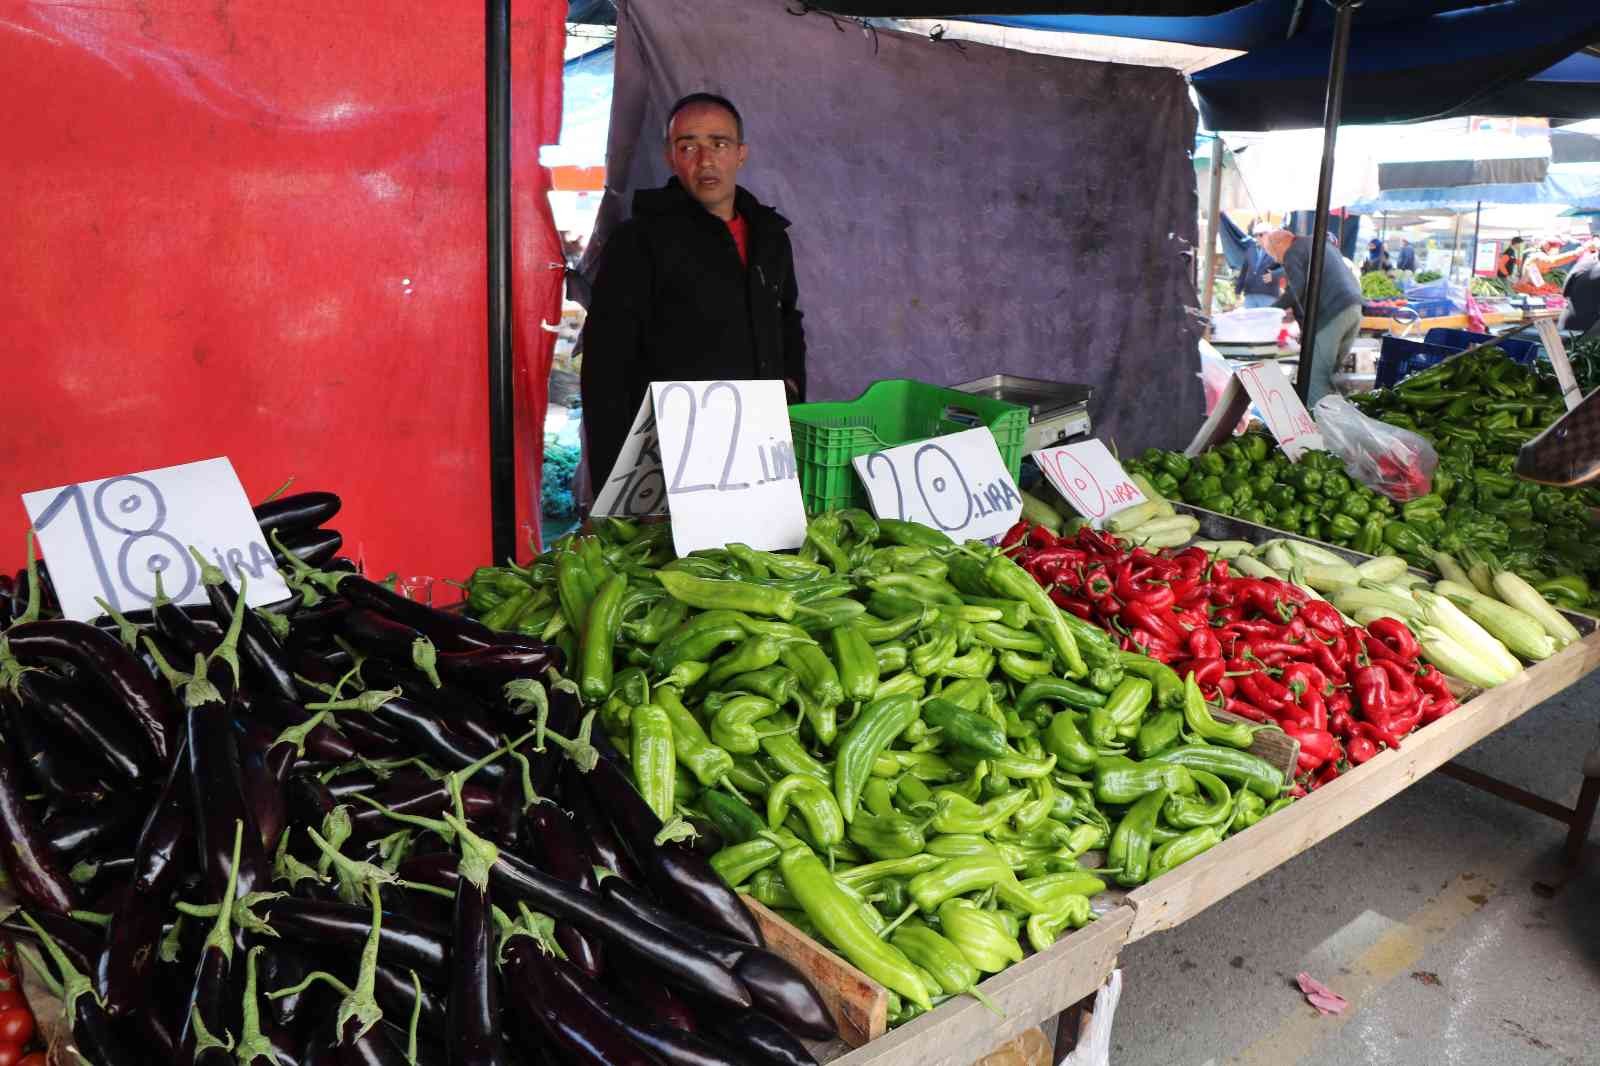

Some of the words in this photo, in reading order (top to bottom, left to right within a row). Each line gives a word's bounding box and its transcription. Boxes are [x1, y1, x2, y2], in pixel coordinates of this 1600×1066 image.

[657, 381, 750, 494] 22
[1040, 450, 1106, 518] 10
[33, 475, 197, 611] 18
